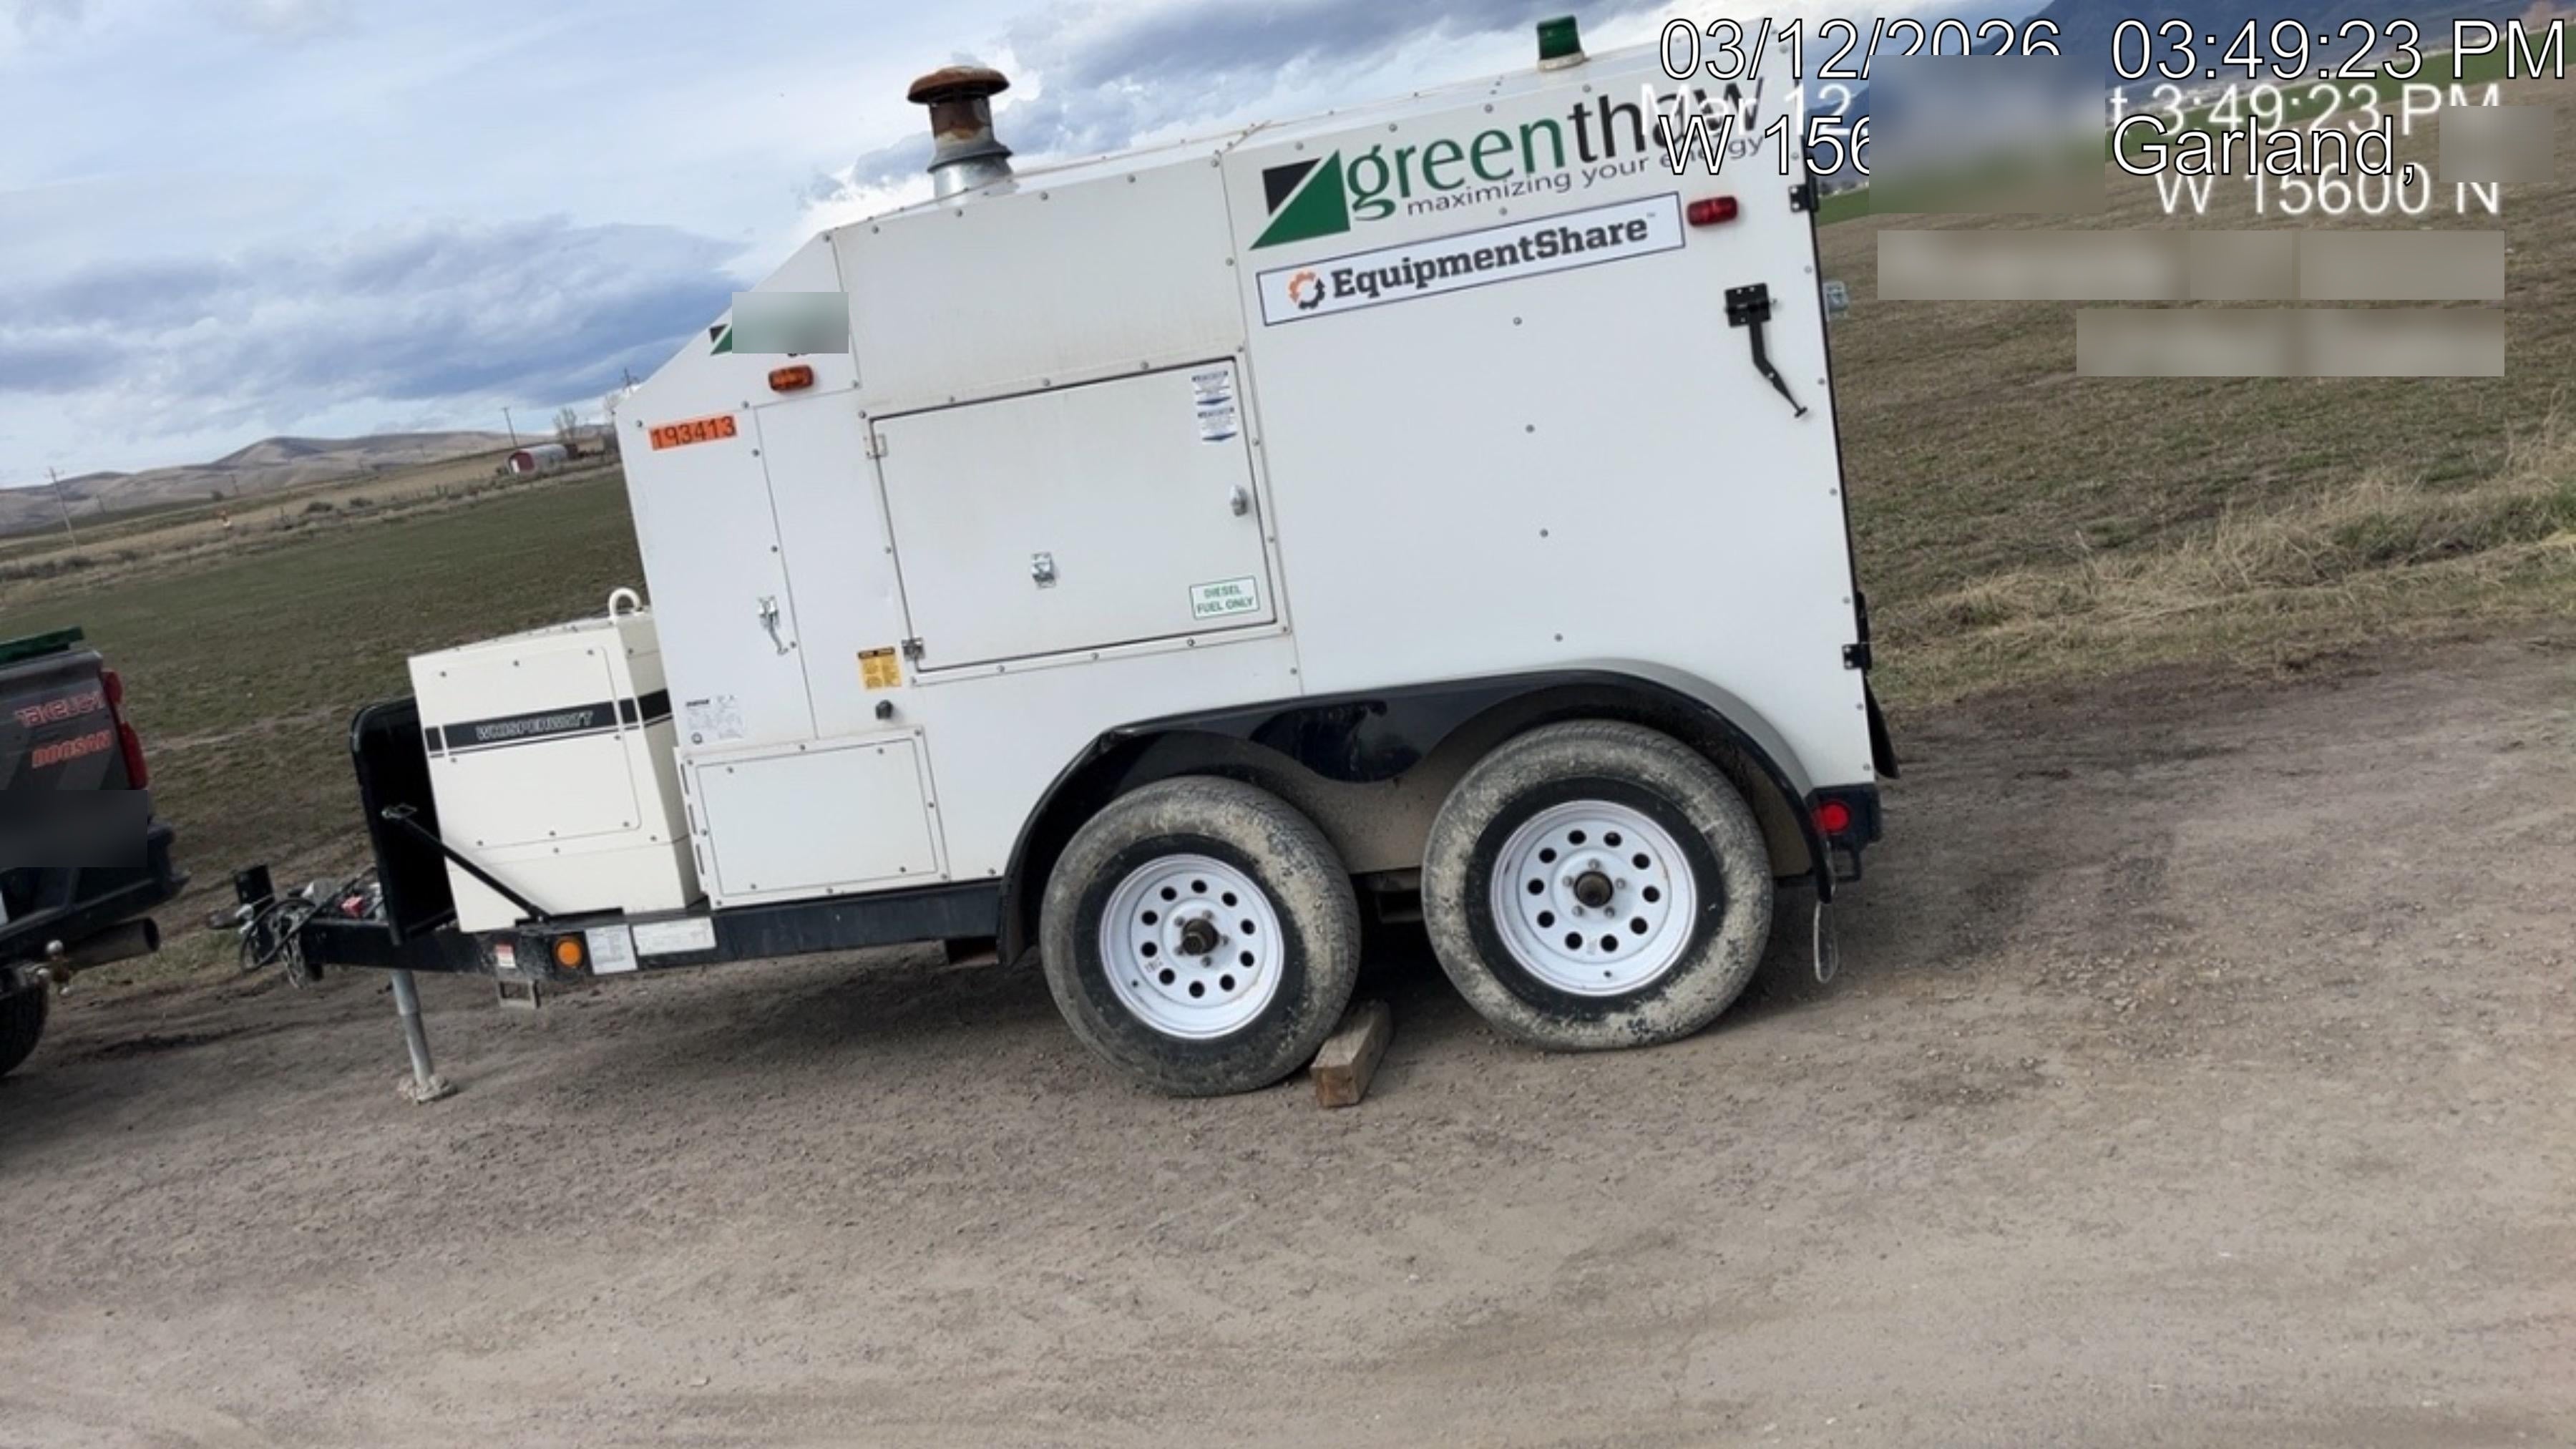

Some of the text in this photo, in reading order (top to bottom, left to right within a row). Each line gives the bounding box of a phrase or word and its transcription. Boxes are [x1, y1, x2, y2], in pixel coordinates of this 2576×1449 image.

[1407, 172, 1572, 216] maximizing
[1582, 157, 1649, 188] your
[1330, 218, 1649, 298] EquipmentShare
[651, 416, 736, 449] 193413
[1196, 596, 1254, 613] FUEL ONLY
